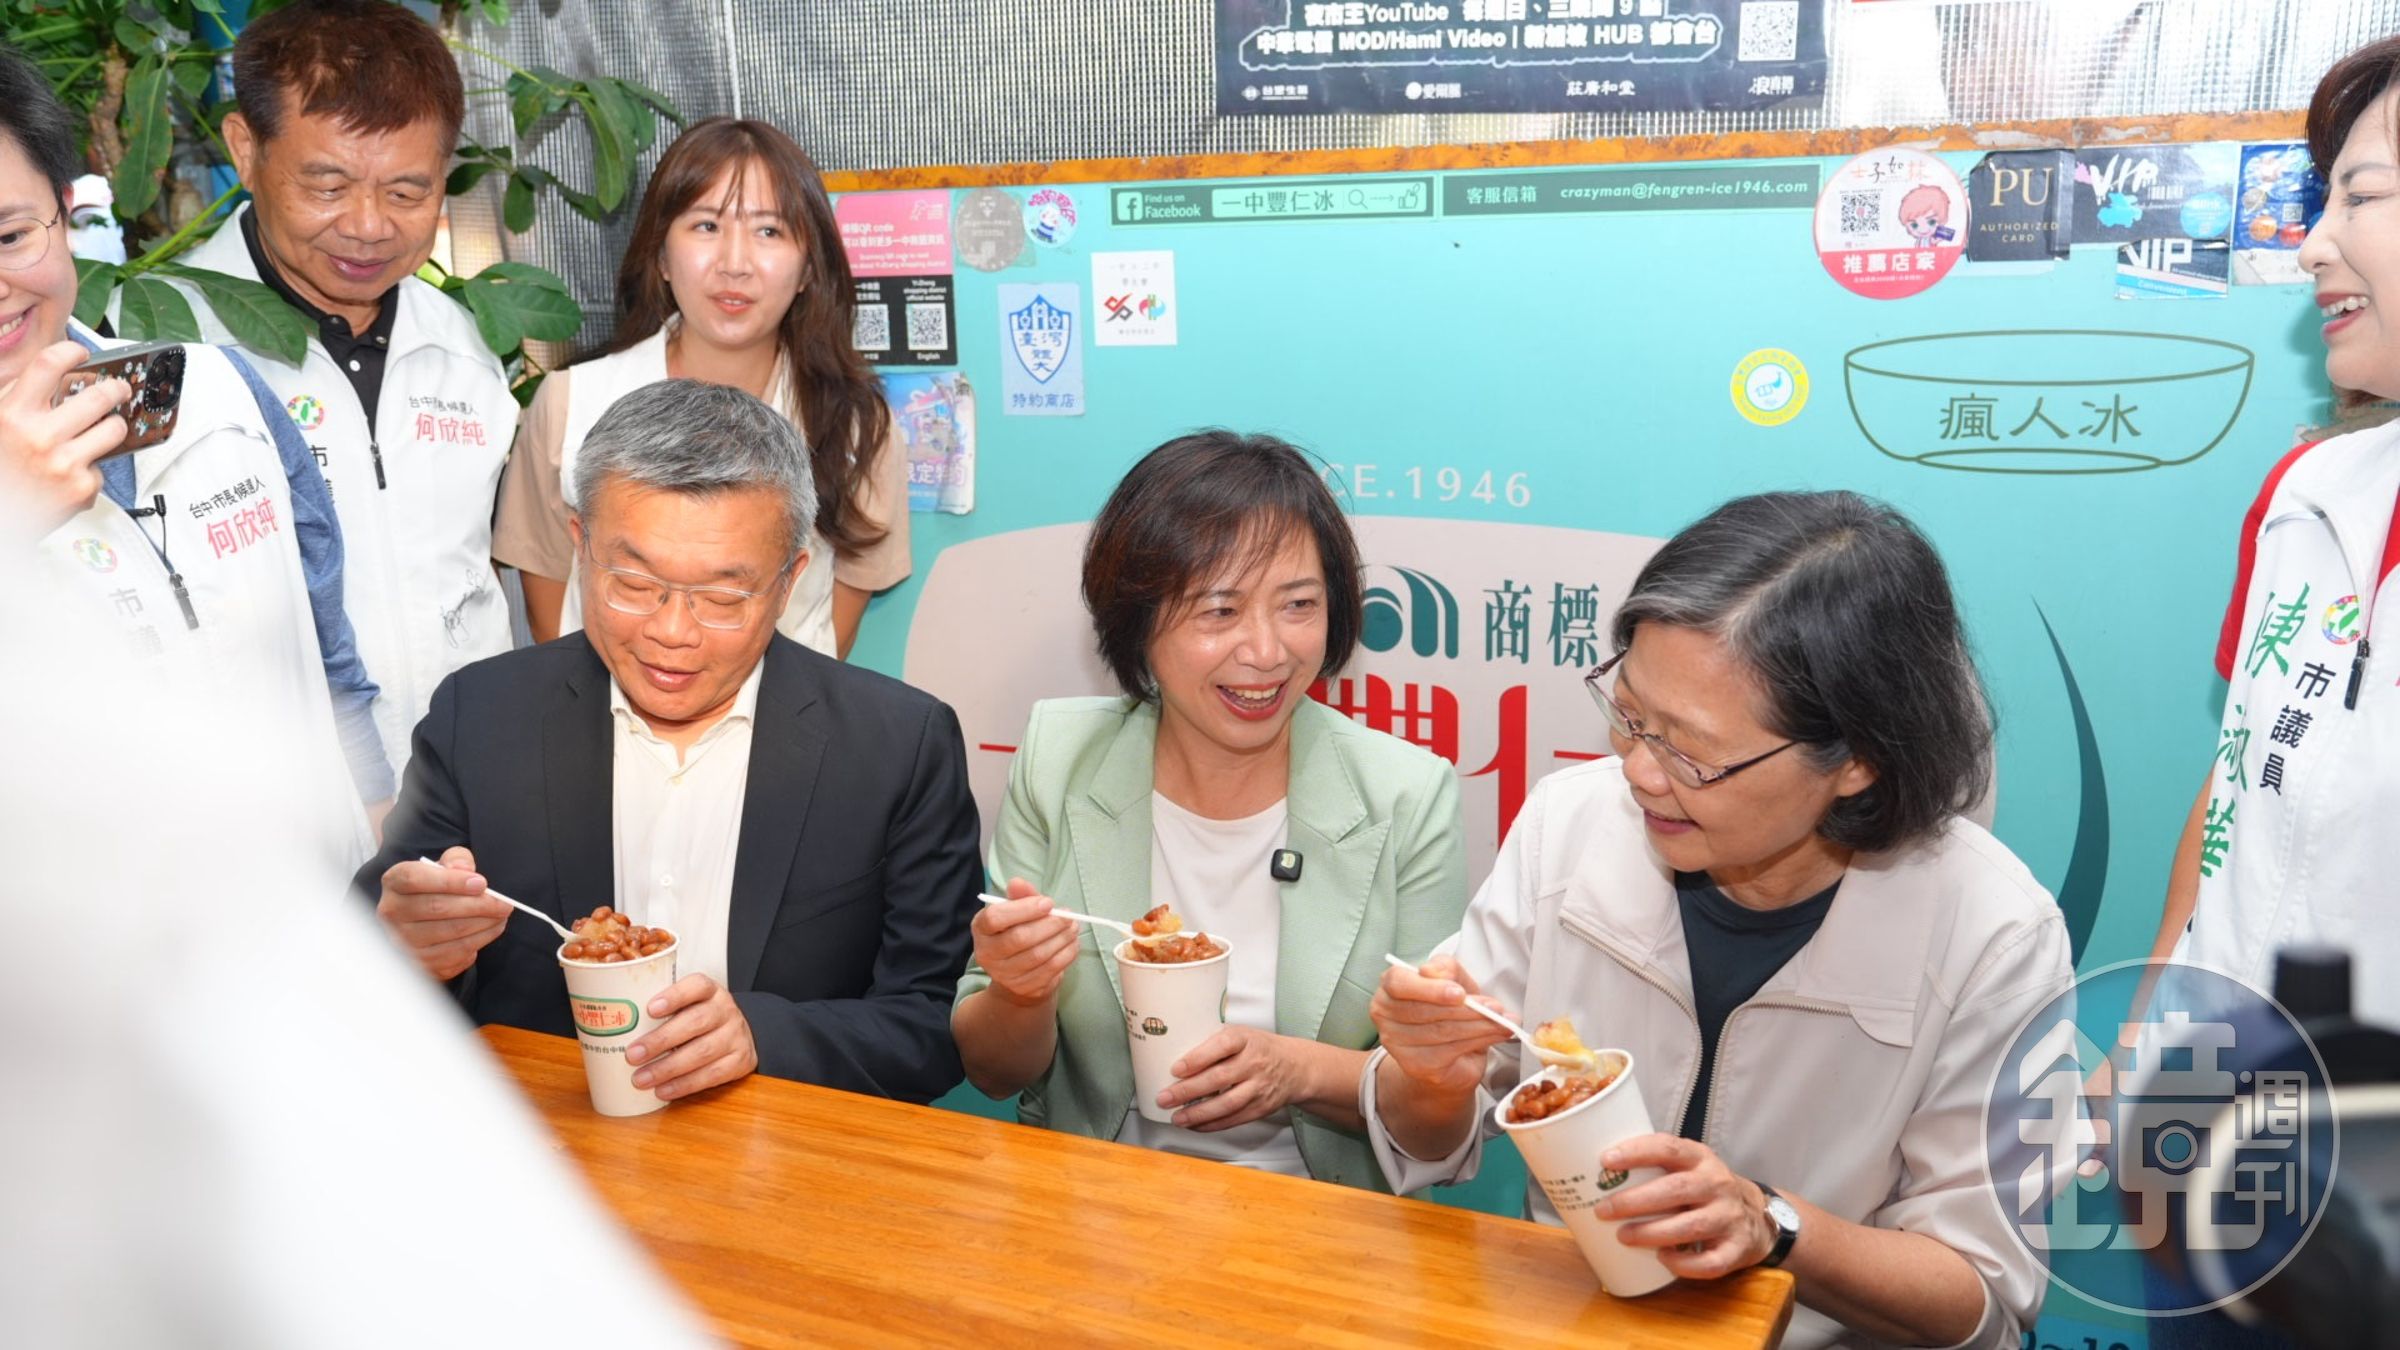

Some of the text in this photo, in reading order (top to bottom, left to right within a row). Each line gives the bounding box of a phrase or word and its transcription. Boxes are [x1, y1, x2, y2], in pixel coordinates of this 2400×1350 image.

[1304, 3, 1449, 27] 夜市王YouTube
[1257, 30, 1333, 54] 中華電信
[1338, 28, 1442, 51] MOD/Hami
[1447, 27, 1506, 49] Video
[1594, 24, 1643, 45] HUB
[1144, 194, 1186, 203] Find us on
[1466, 185, 1537, 204] 客服信箱
[1560, 180, 1809, 200] crazyman@fengren-ice1946.com
[1988, 167, 2054, 207] PU
[1144, 203, 1201, 219] Facebook
[1221, 189, 1335, 214] 一中豐仁冰
[1979, 222, 2061, 233] AUTHORIZED
[2001, 233, 2036, 243] CARD
[1843, 252, 1936, 274] 推薦店家
[2125, 238, 2193, 272] VIP
[1012, 393, 1075, 408] 特約商店
[416, 412, 486, 446] 何欣純
[1939, 393, 2142, 444] 瘋人冰
[189, 475, 266, 519] 台中市長候選人
[1319, 463, 1532, 509] CE.1946
[206, 496, 279, 560] 何欣純
[1482, 579, 1600, 669] 商標
[2259, 662, 2337, 796] 市議員
